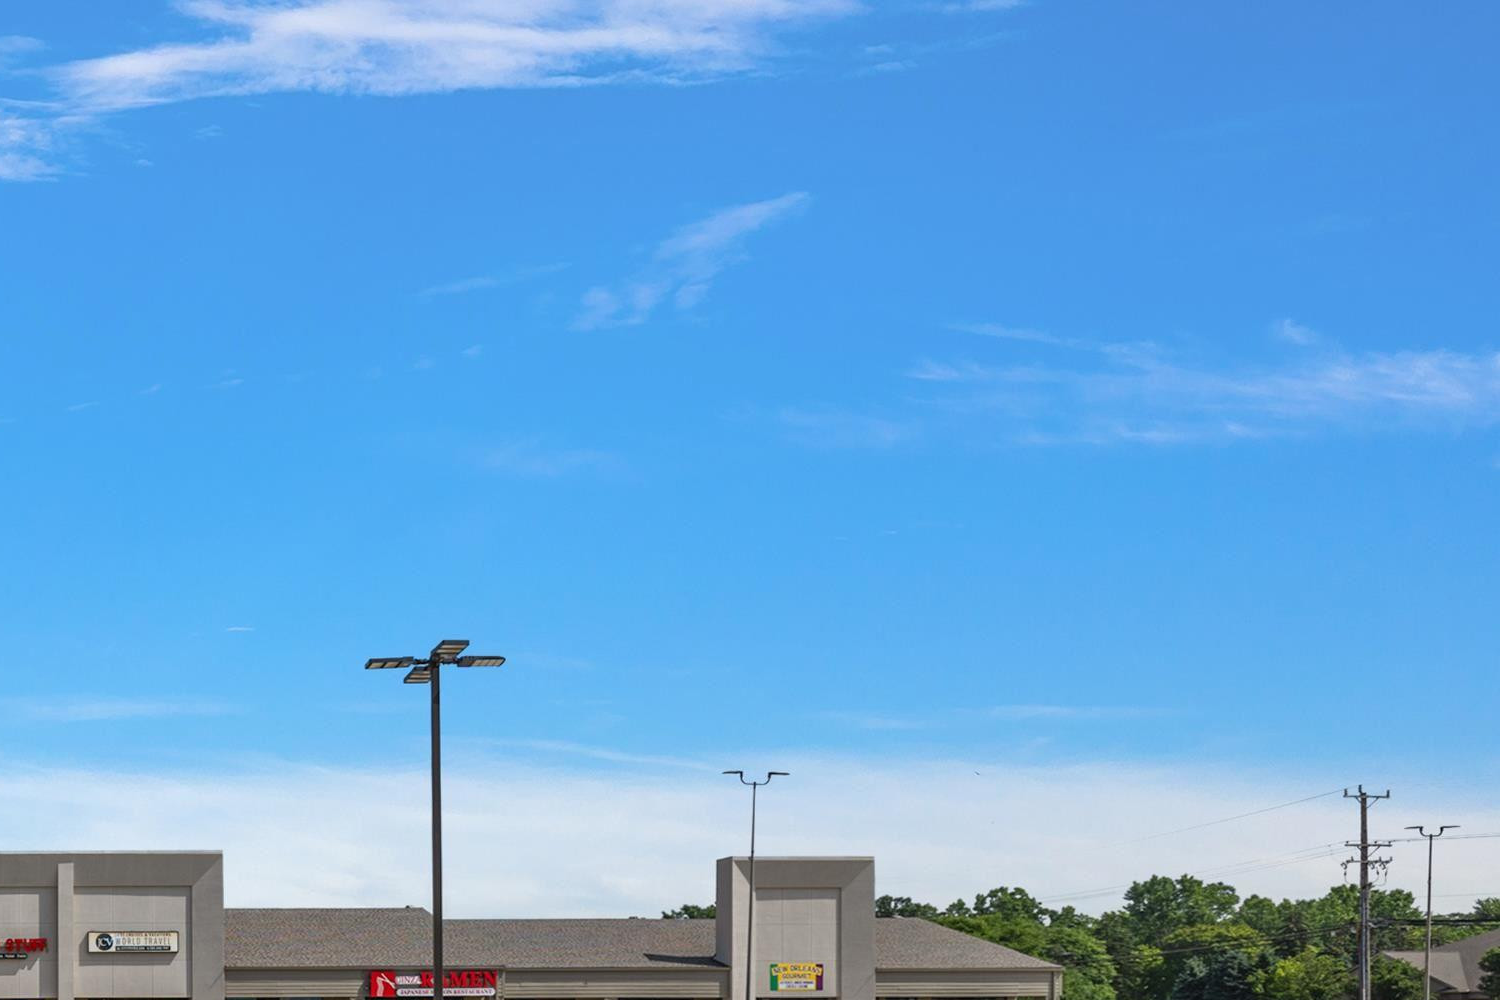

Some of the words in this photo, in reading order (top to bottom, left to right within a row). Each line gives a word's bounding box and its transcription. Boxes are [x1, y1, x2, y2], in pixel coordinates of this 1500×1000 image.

[5, 938, 47, 953] STUFF
[115, 937, 140, 945] WORLD
[144, 937, 171, 945] TRAVEL
[772, 965, 788, 976] NEW
[789, 963, 822, 976] ORLEANS
